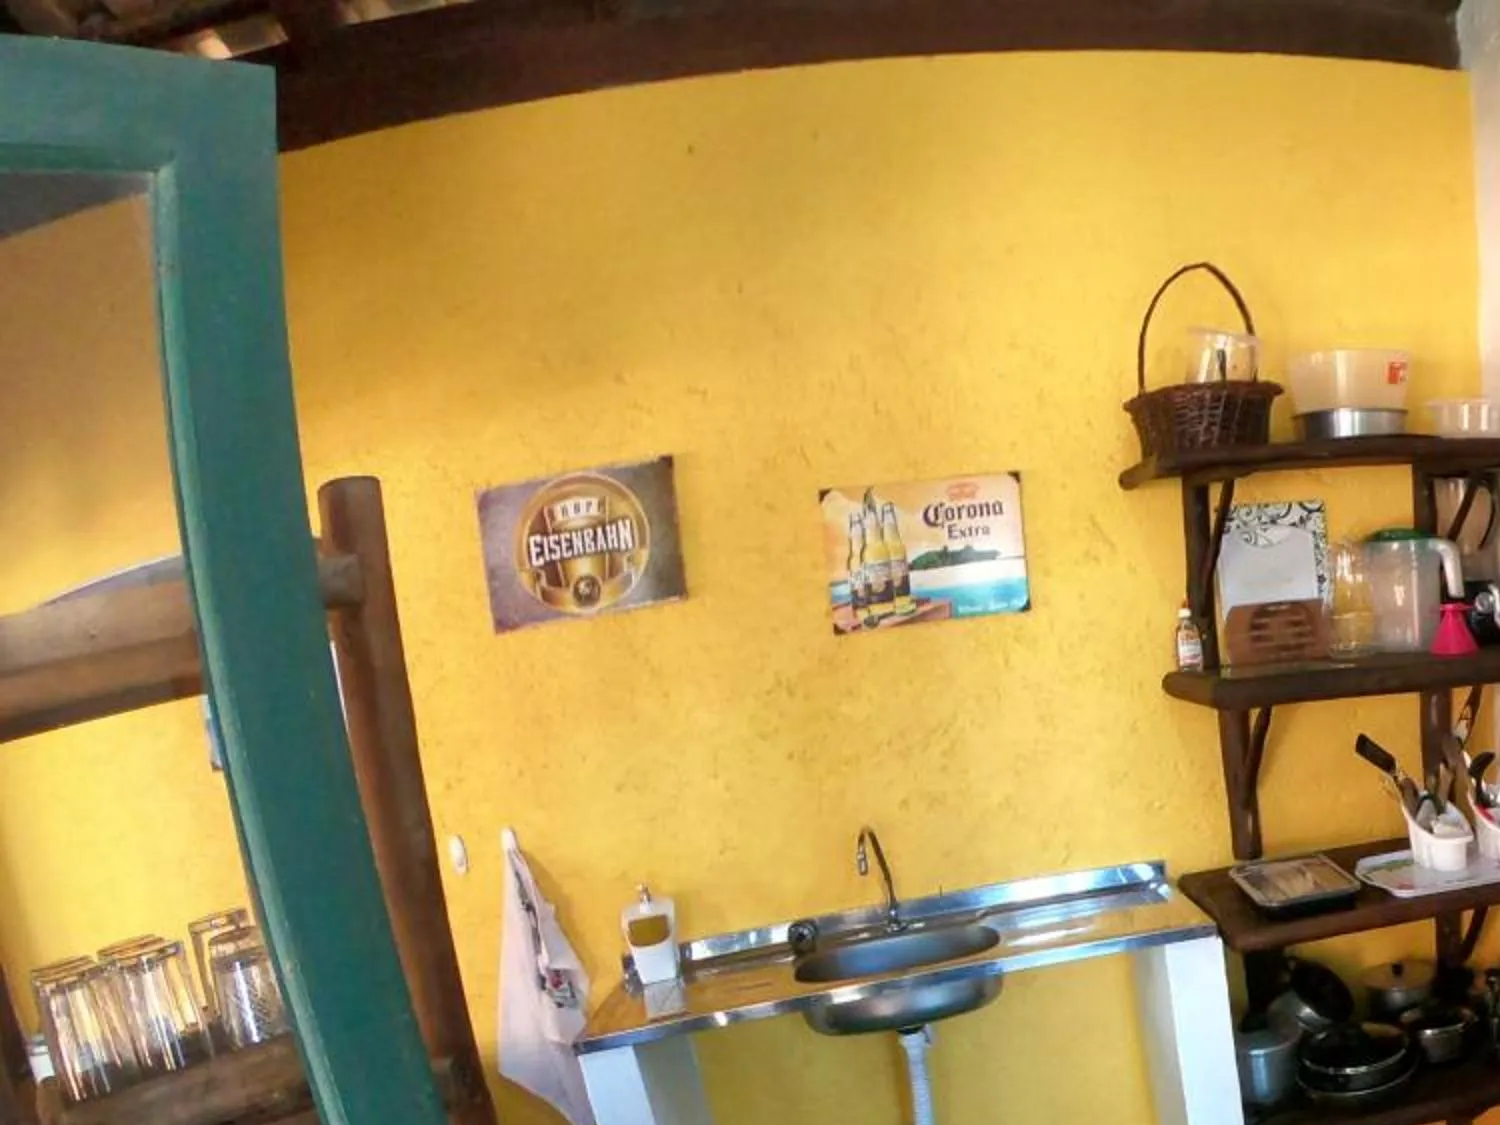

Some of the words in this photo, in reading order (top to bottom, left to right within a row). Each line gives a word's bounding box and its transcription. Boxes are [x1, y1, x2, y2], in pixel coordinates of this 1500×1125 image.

[923, 499, 1004, 529] Corona
[528, 517, 633, 568] EISENBAHN
[946, 523, 991, 540] Extra
